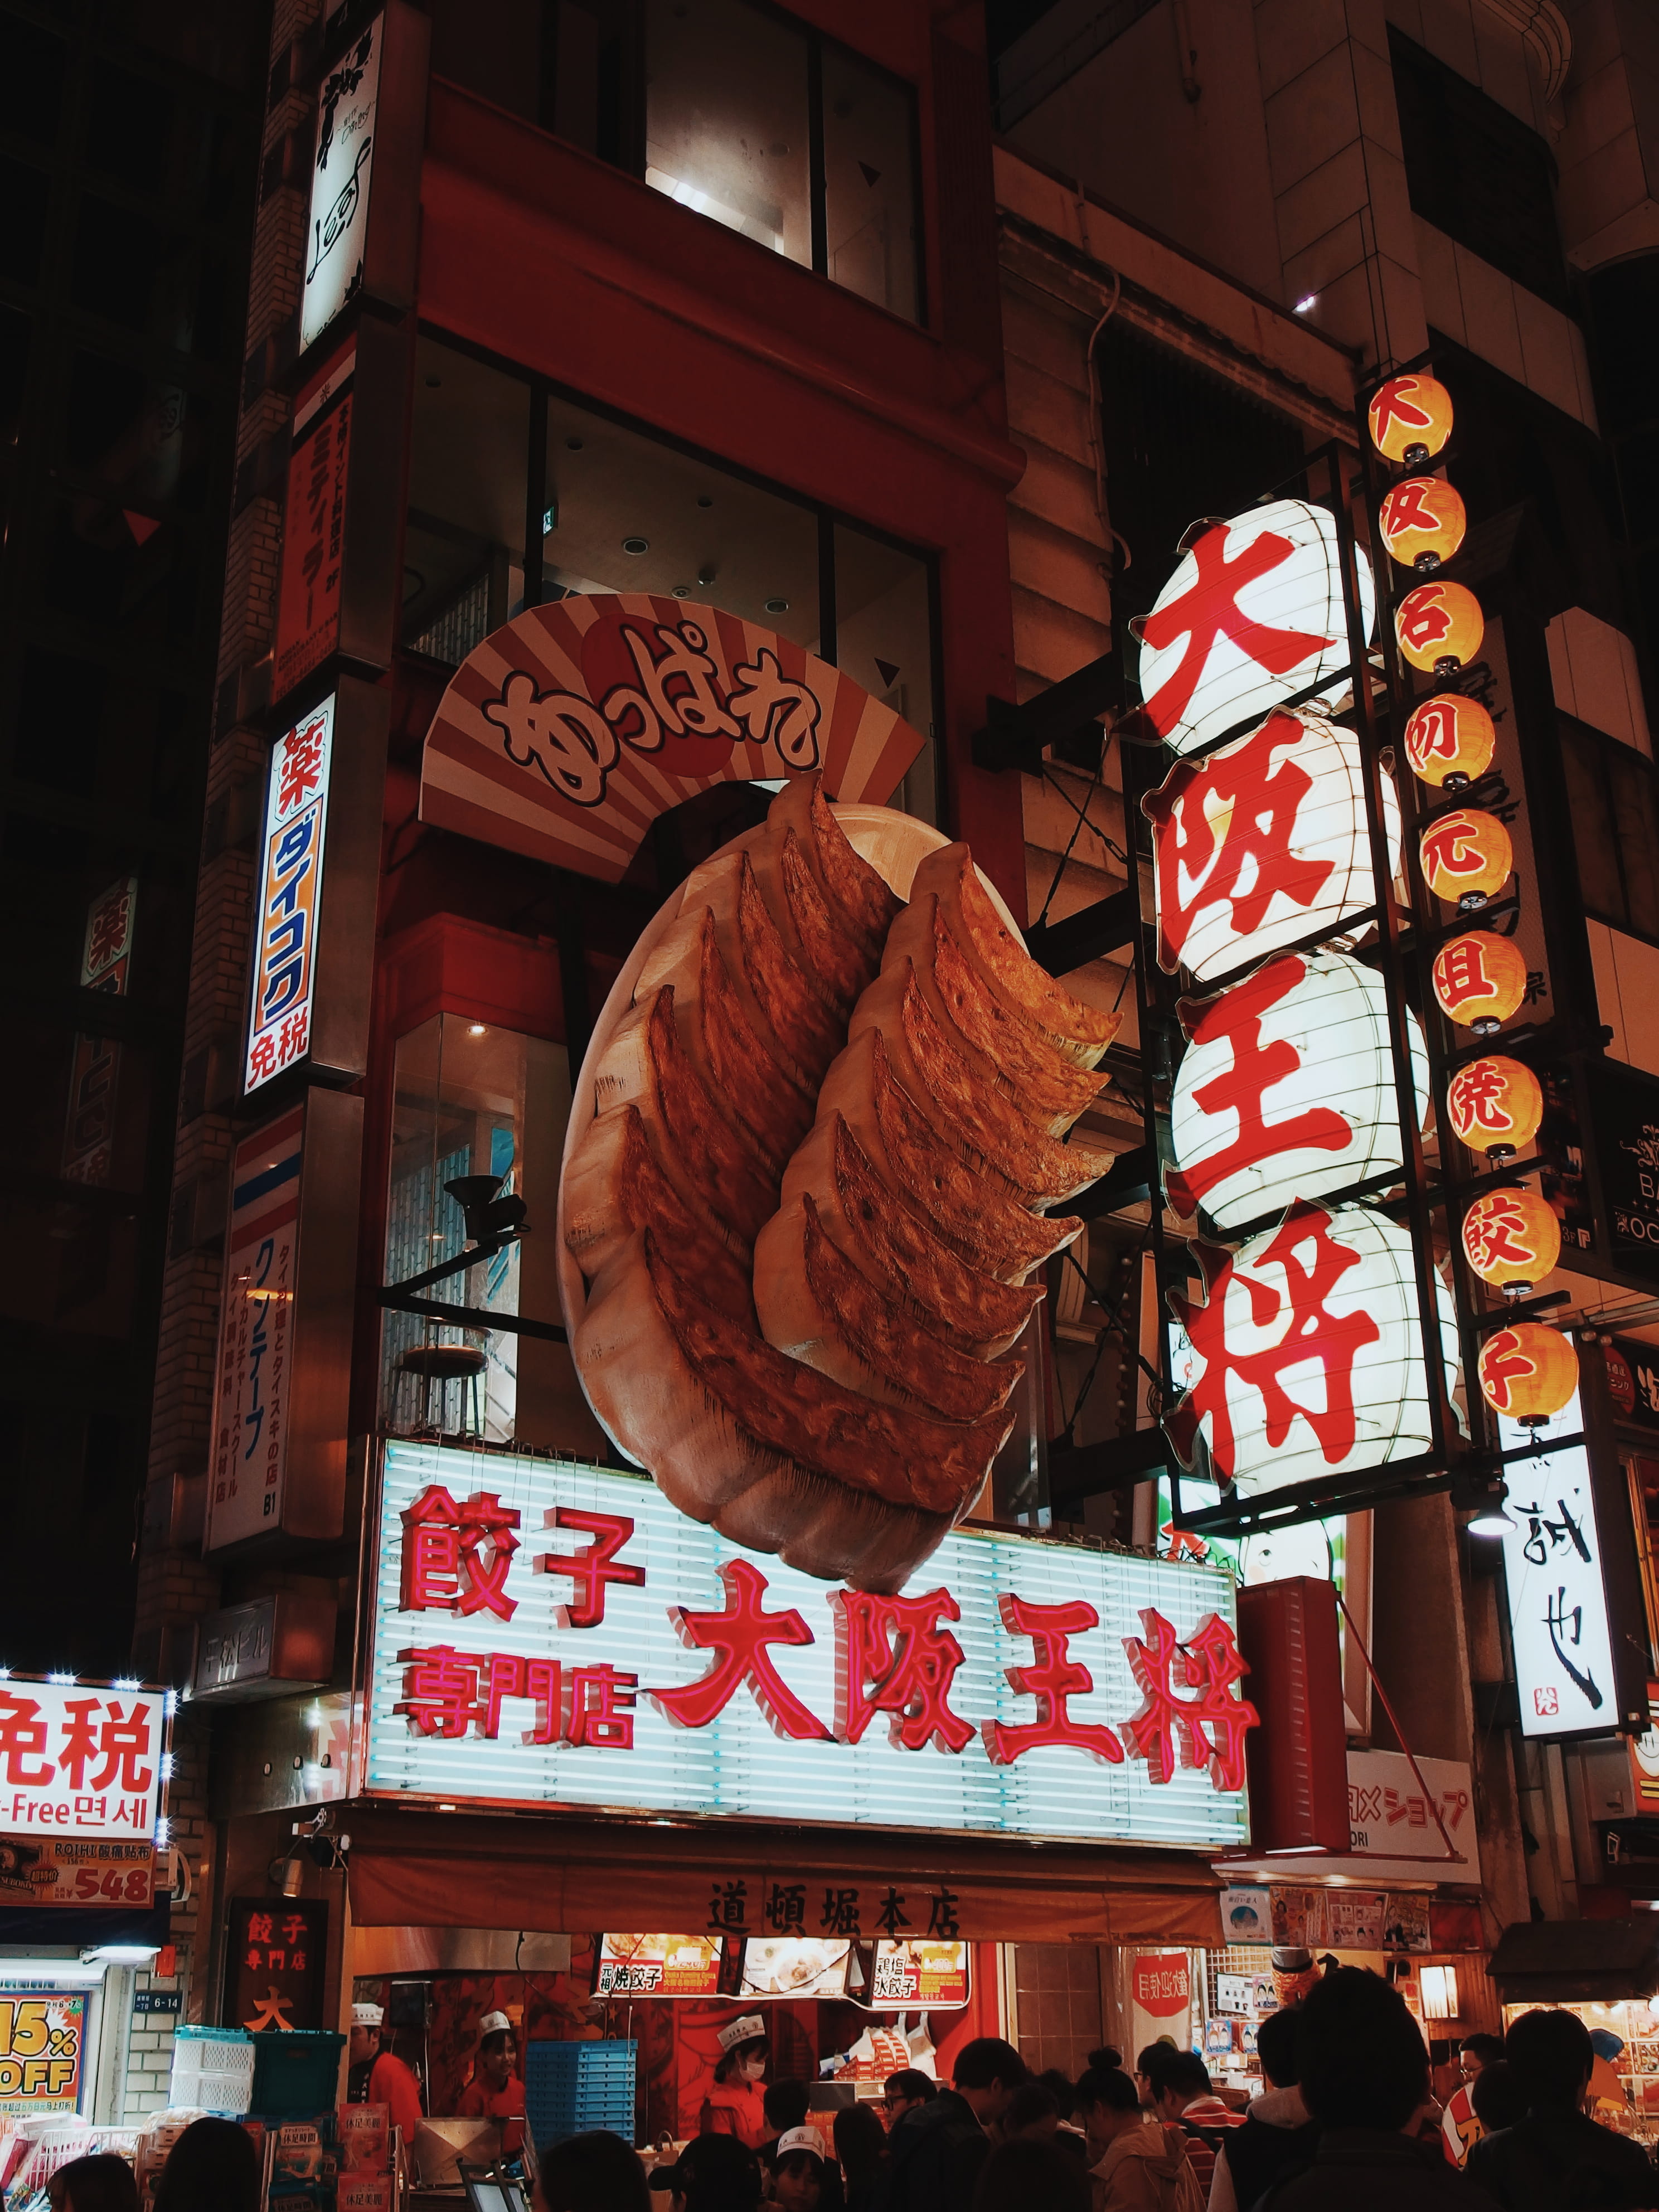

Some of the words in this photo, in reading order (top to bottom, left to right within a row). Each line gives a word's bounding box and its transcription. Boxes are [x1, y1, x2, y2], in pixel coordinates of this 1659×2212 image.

[306, 135, 372, 285] Leaf
[326, 567, 339, 594] 2F
[481, 619, 822, 807] あっぱれ
[278, 726, 324, 816] 薬
[263, 808, 317, 1023] ダイコク
[1107, 516, 1380, 1491] 大阪王将
[248, 1006, 308, 1089] 免税
[228, 1265, 251, 1500] タイカルチャースクール
[263, 1492, 276, 1516] B1
[398, 1484, 647, 1630] 餃子
[392, 1644, 639, 1750] 専門店
[637, 1559, 1262, 1792] 大阪王将
[0, 1690, 152, 1793] 免税
[55, 1843, 96, 1857] ROIHI
[248, 1912, 308, 1944] 餃子
[706, 1880, 961, 1941] 道頓堀本店
[244, 1949, 307, 1971] 専門店
[601, 1963, 613, 1991] 元祖
[613, 1966, 661, 1989] 焼餃子
[874, 1977, 916, 1996] 水餃子
[154, 1998, 177, 2009] 6-14
[283, 2133, 316, 2144] 休足時間
